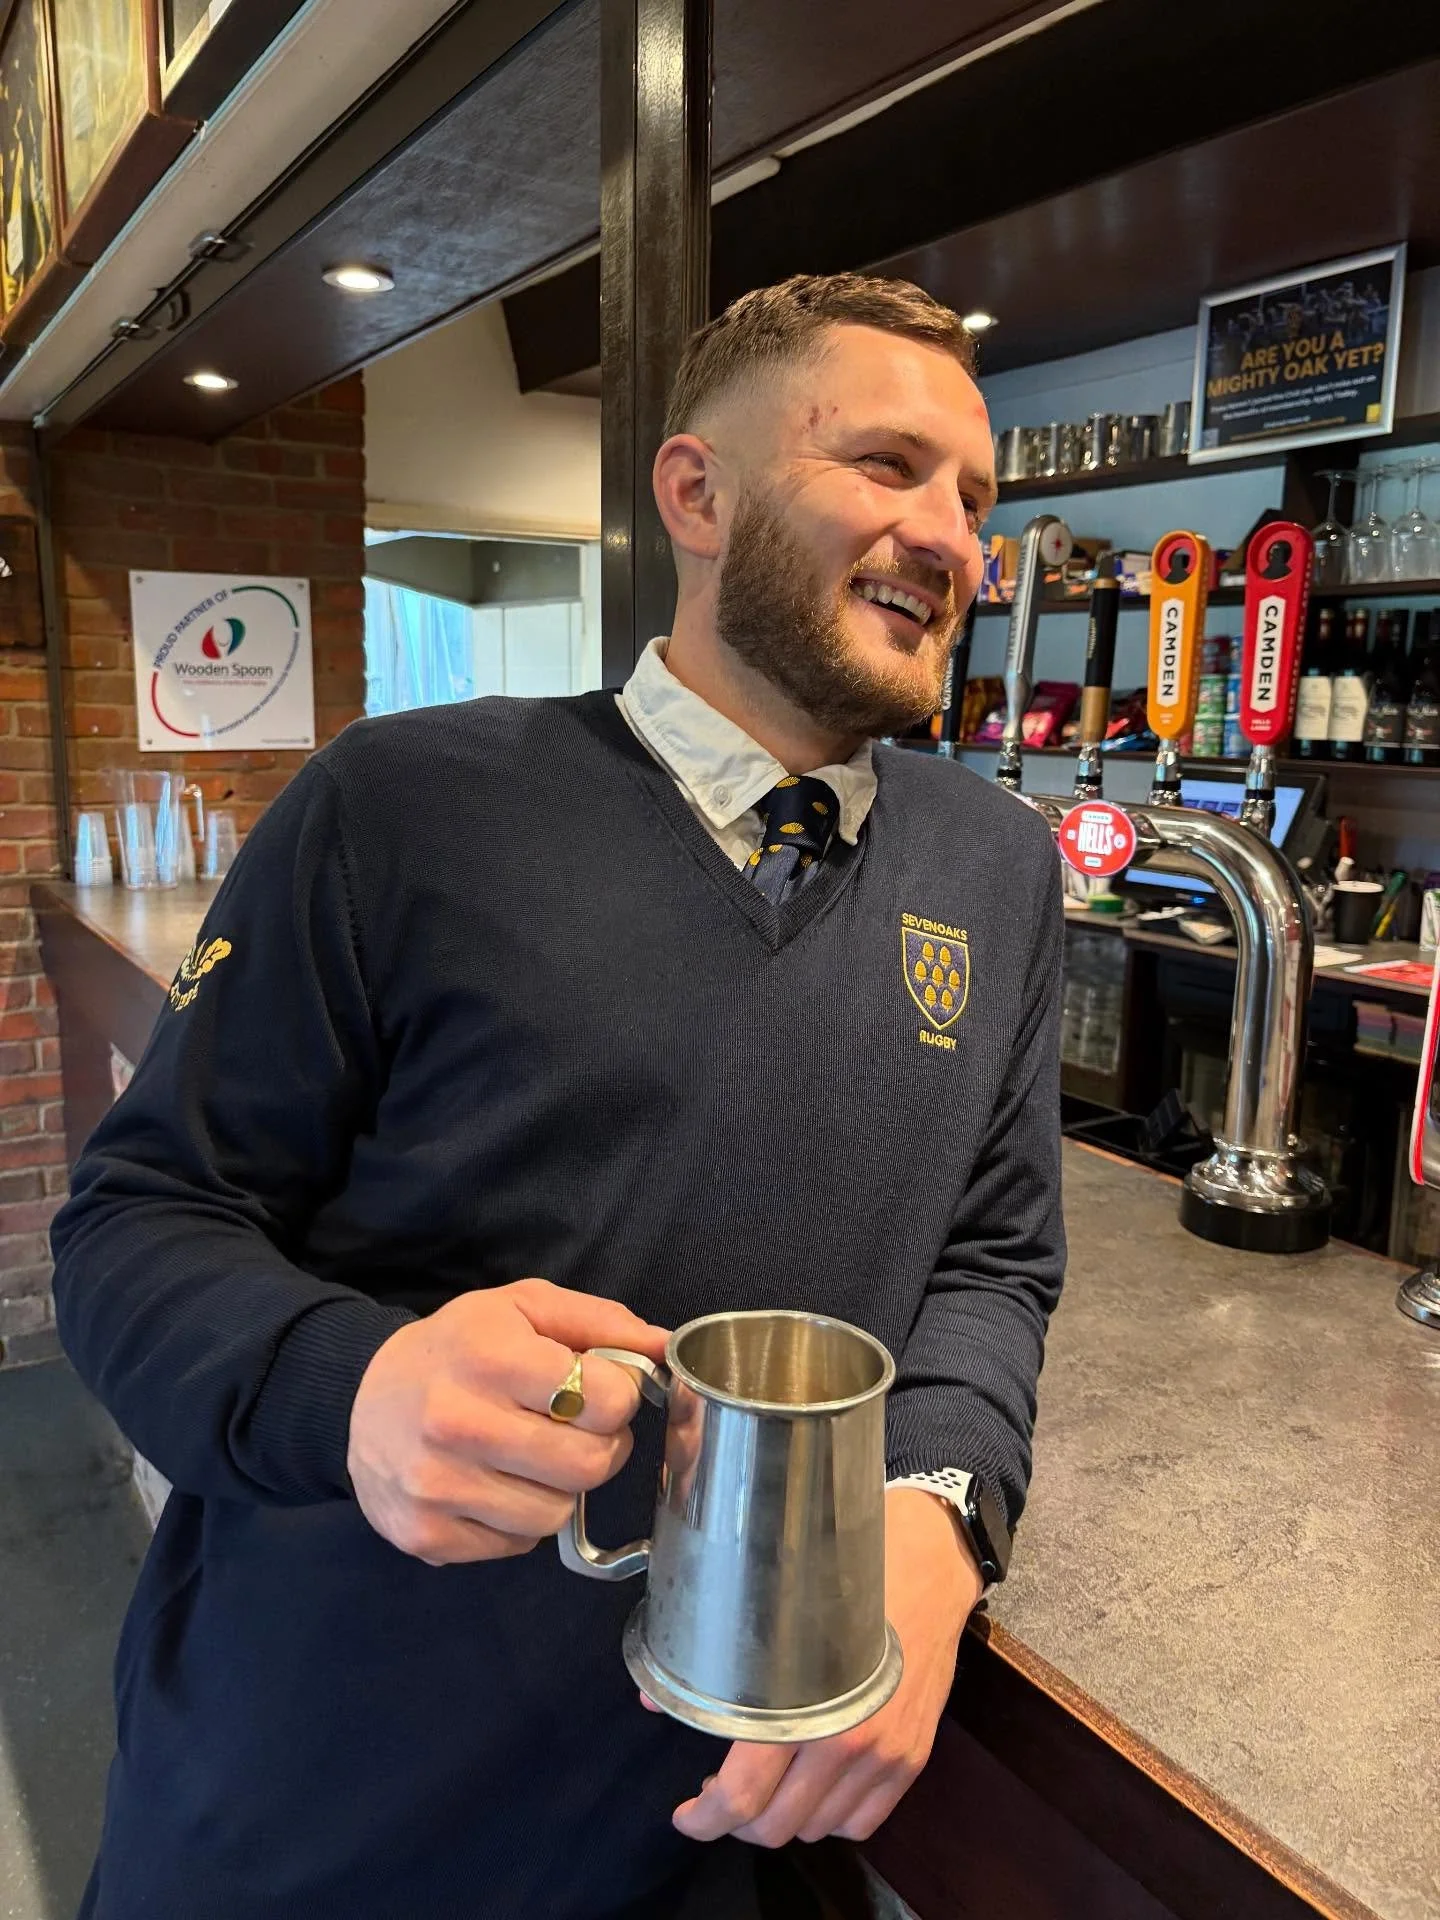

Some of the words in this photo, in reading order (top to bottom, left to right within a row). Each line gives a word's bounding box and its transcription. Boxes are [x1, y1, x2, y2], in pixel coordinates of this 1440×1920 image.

[1208, 368, 1281, 397] MIGHTY
[1284, 357, 1329, 380] OAK
[1334, 342, 1386, 371] YET?
[1242, 345, 1279, 371] ARE
[1282, 334, 1326, 360] YOU
[1330, 330, 1346, 350] A
[153, 633, 178, 669] PROUD
[175, 598, 216, 634] PARTNER
[215, 589, 230, 602] OF
[174, 662, 229, 676] Wooden
[231, 662, 274, 678] Spoon
[1161, 606, 1179, 697] CAMDEN
[1257, 604, 1279, 701] CAMDEN
[1077, 821, 1115, 856] HELLS
[902, 912, 968, 941] SEVENOAKS
[919, 1030, 957, 1050] RUGBY
